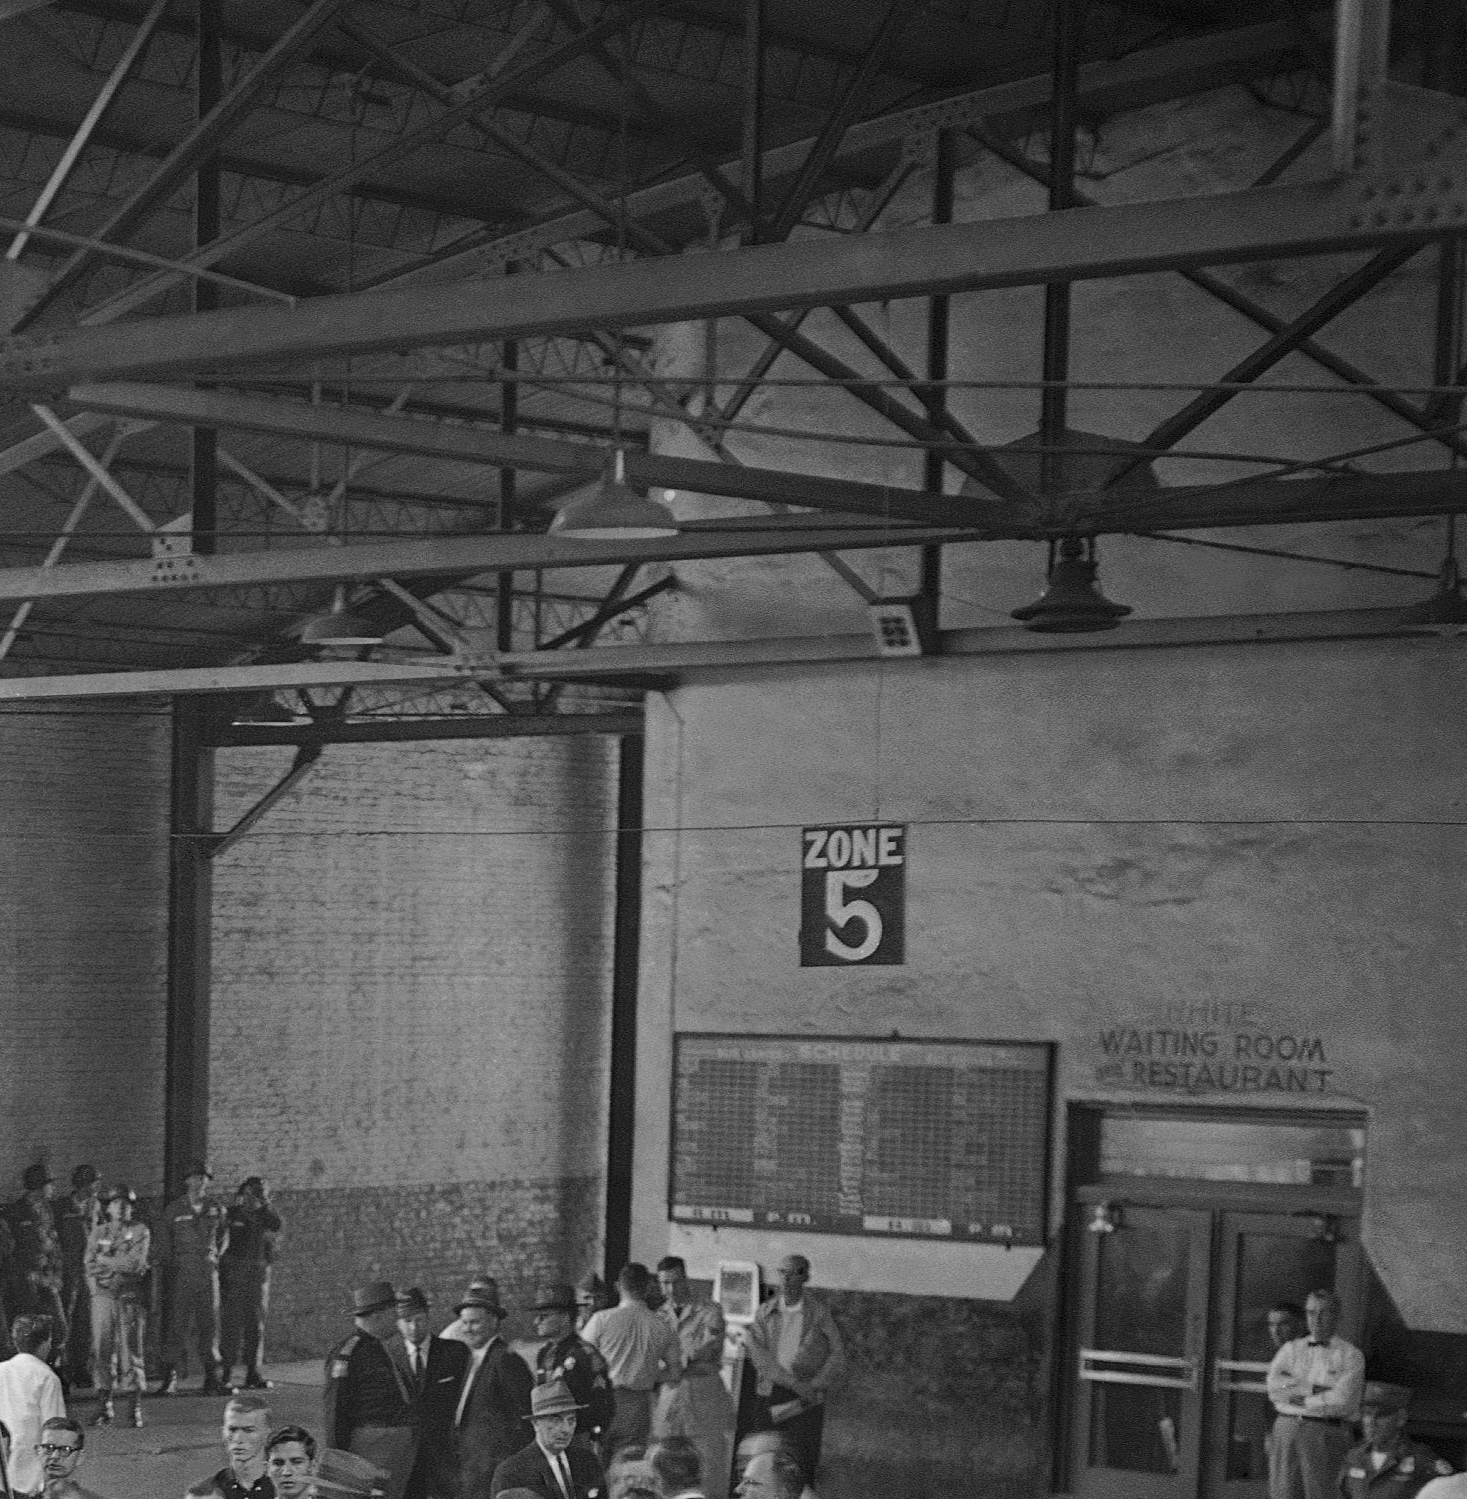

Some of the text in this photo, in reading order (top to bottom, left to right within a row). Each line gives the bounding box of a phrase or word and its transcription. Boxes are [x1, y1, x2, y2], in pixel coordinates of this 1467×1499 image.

[803, 826, 903, 868] ZONE
[824, 869, 883, 961] 5
[798, 1043, 902, 1062] SCHEDULE
[1098, 1029, 1328, 1062] WAITING ROOM
[1132, 1061, 1333, 1092] RESTAURANT
